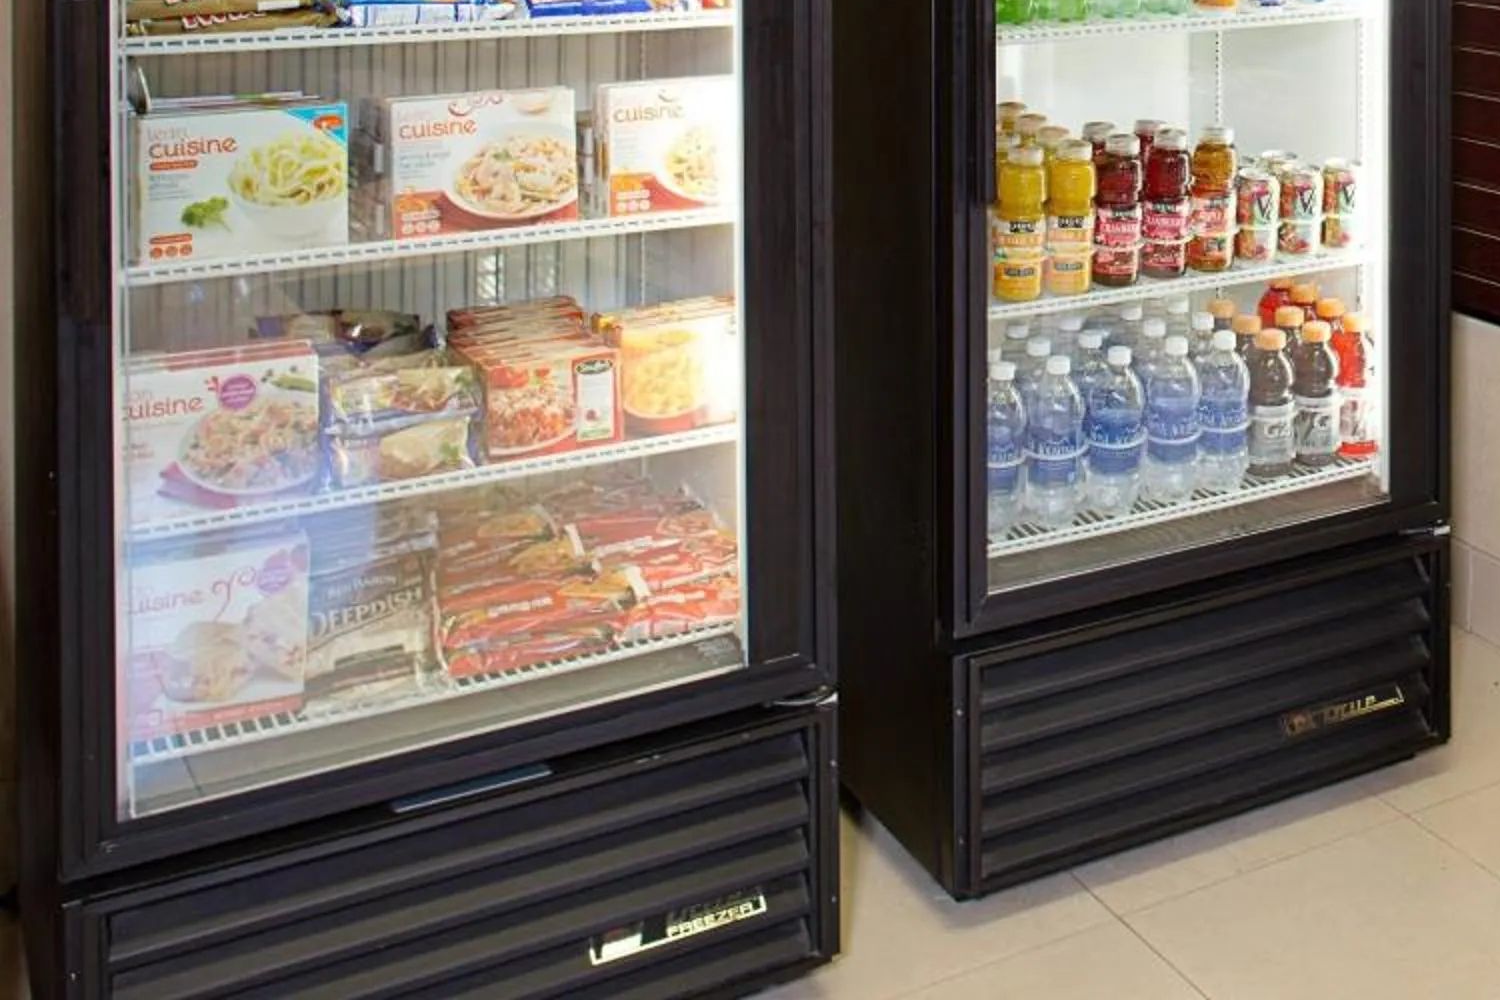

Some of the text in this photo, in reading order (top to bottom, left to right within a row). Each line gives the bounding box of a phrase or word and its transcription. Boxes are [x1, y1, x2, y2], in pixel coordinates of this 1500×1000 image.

[612, 104, 683, 124] cuisine
[398, 117, 478, 140] cuisine
[148, 135, 238, 160] cuisine
[666, 901, 754, 938] FREEZER
